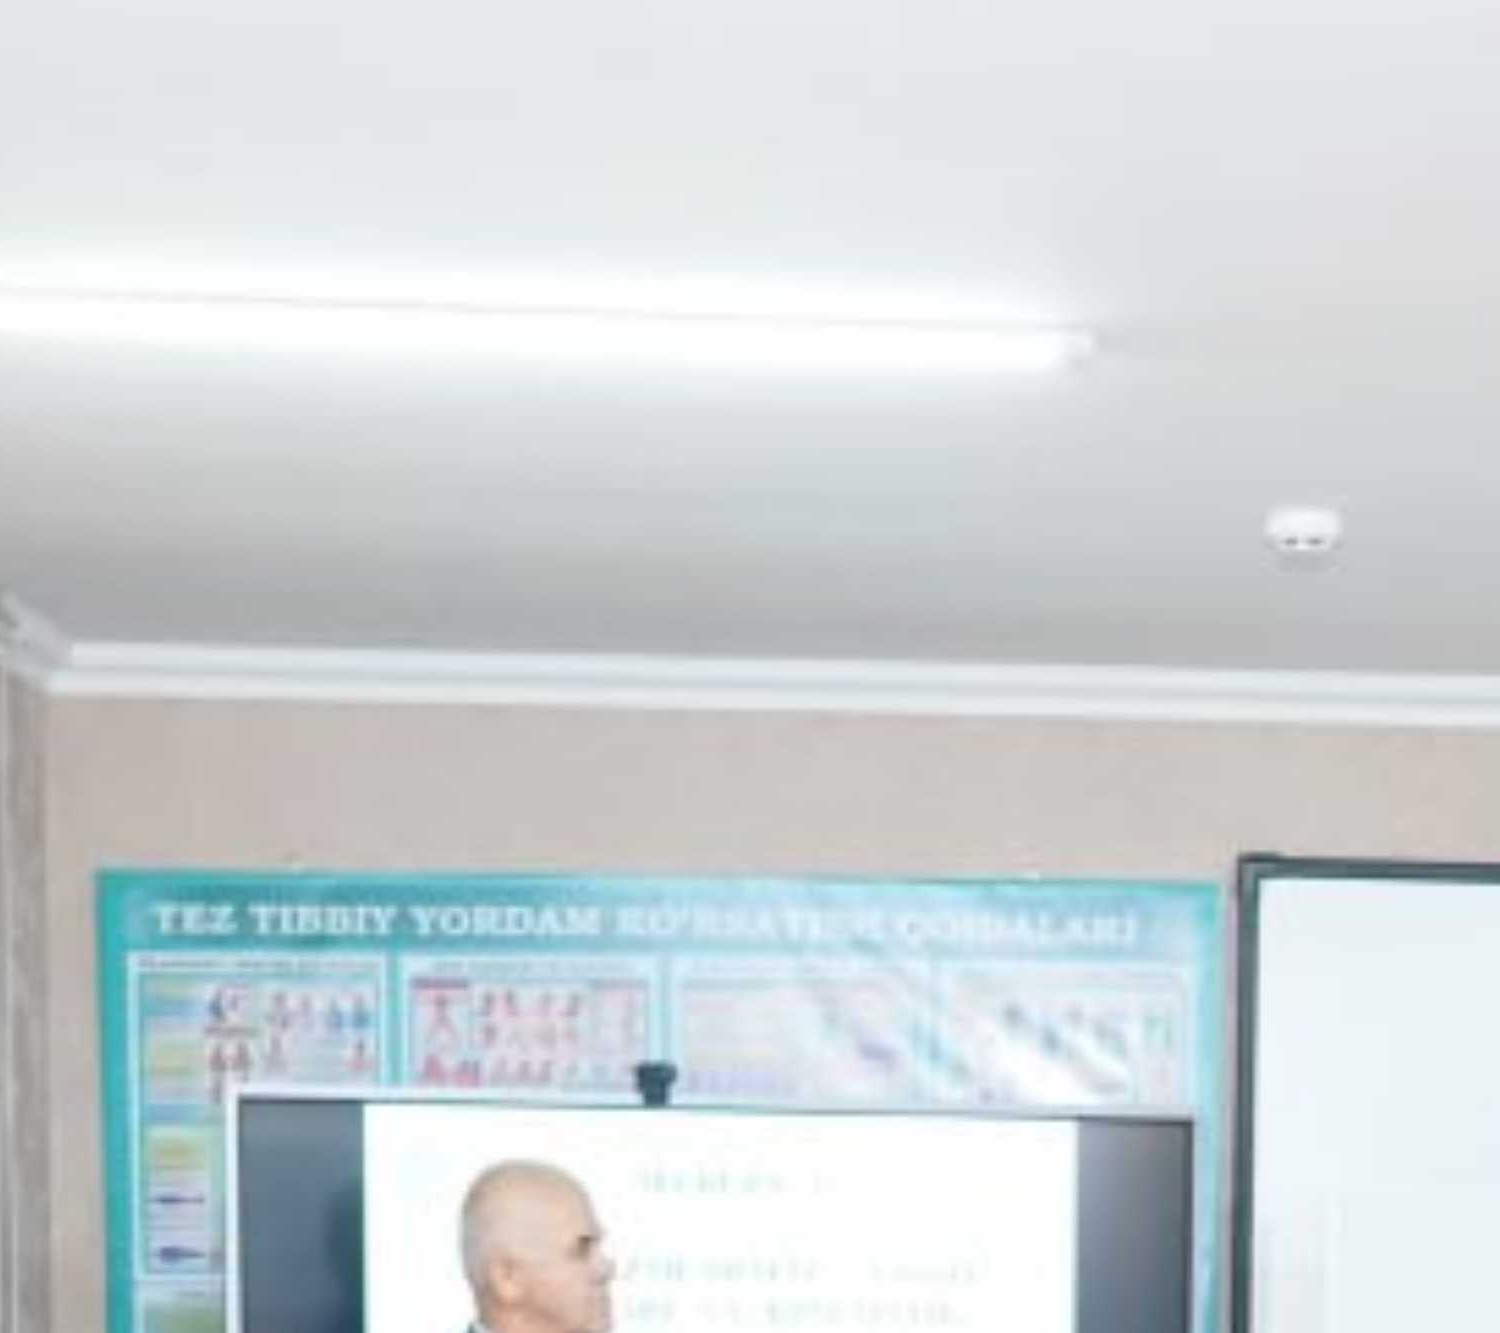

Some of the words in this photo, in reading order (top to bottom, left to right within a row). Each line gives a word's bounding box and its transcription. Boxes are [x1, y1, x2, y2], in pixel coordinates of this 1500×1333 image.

[157, 905, 238, 936] TEZ
[250, 905, 400, 936] TIBBIY
[408, 905, 599, 937] YORDAM
